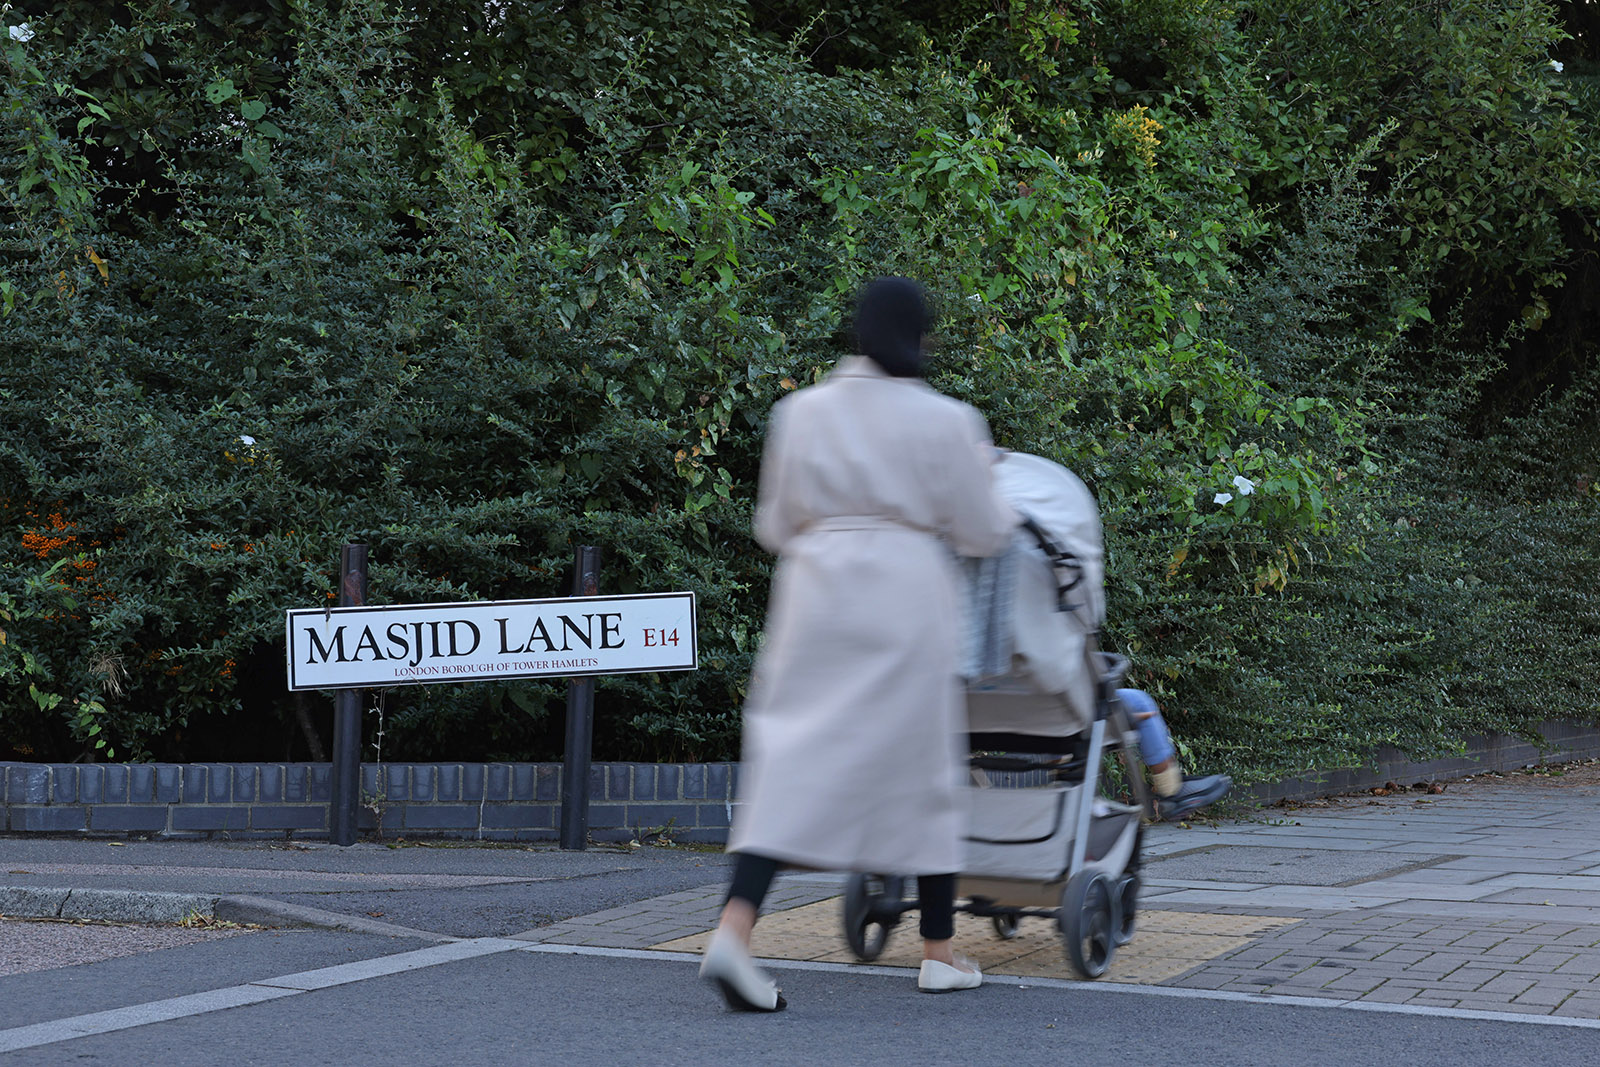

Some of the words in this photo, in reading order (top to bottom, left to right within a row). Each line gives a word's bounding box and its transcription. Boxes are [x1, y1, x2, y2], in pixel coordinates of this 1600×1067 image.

[304, 619, 481, 667] MASJID
[494, 612, 626, 654] LANE
[643, 627, 680, 648] E14
[394, 666, 440, 677] LONDON
[441, 664, 494, 674] BOROUGH
[496, 663, 511, 672] OF
[513, 661, 549, 671] TOWER
[551, 658, 598, 669] HAMLETS
